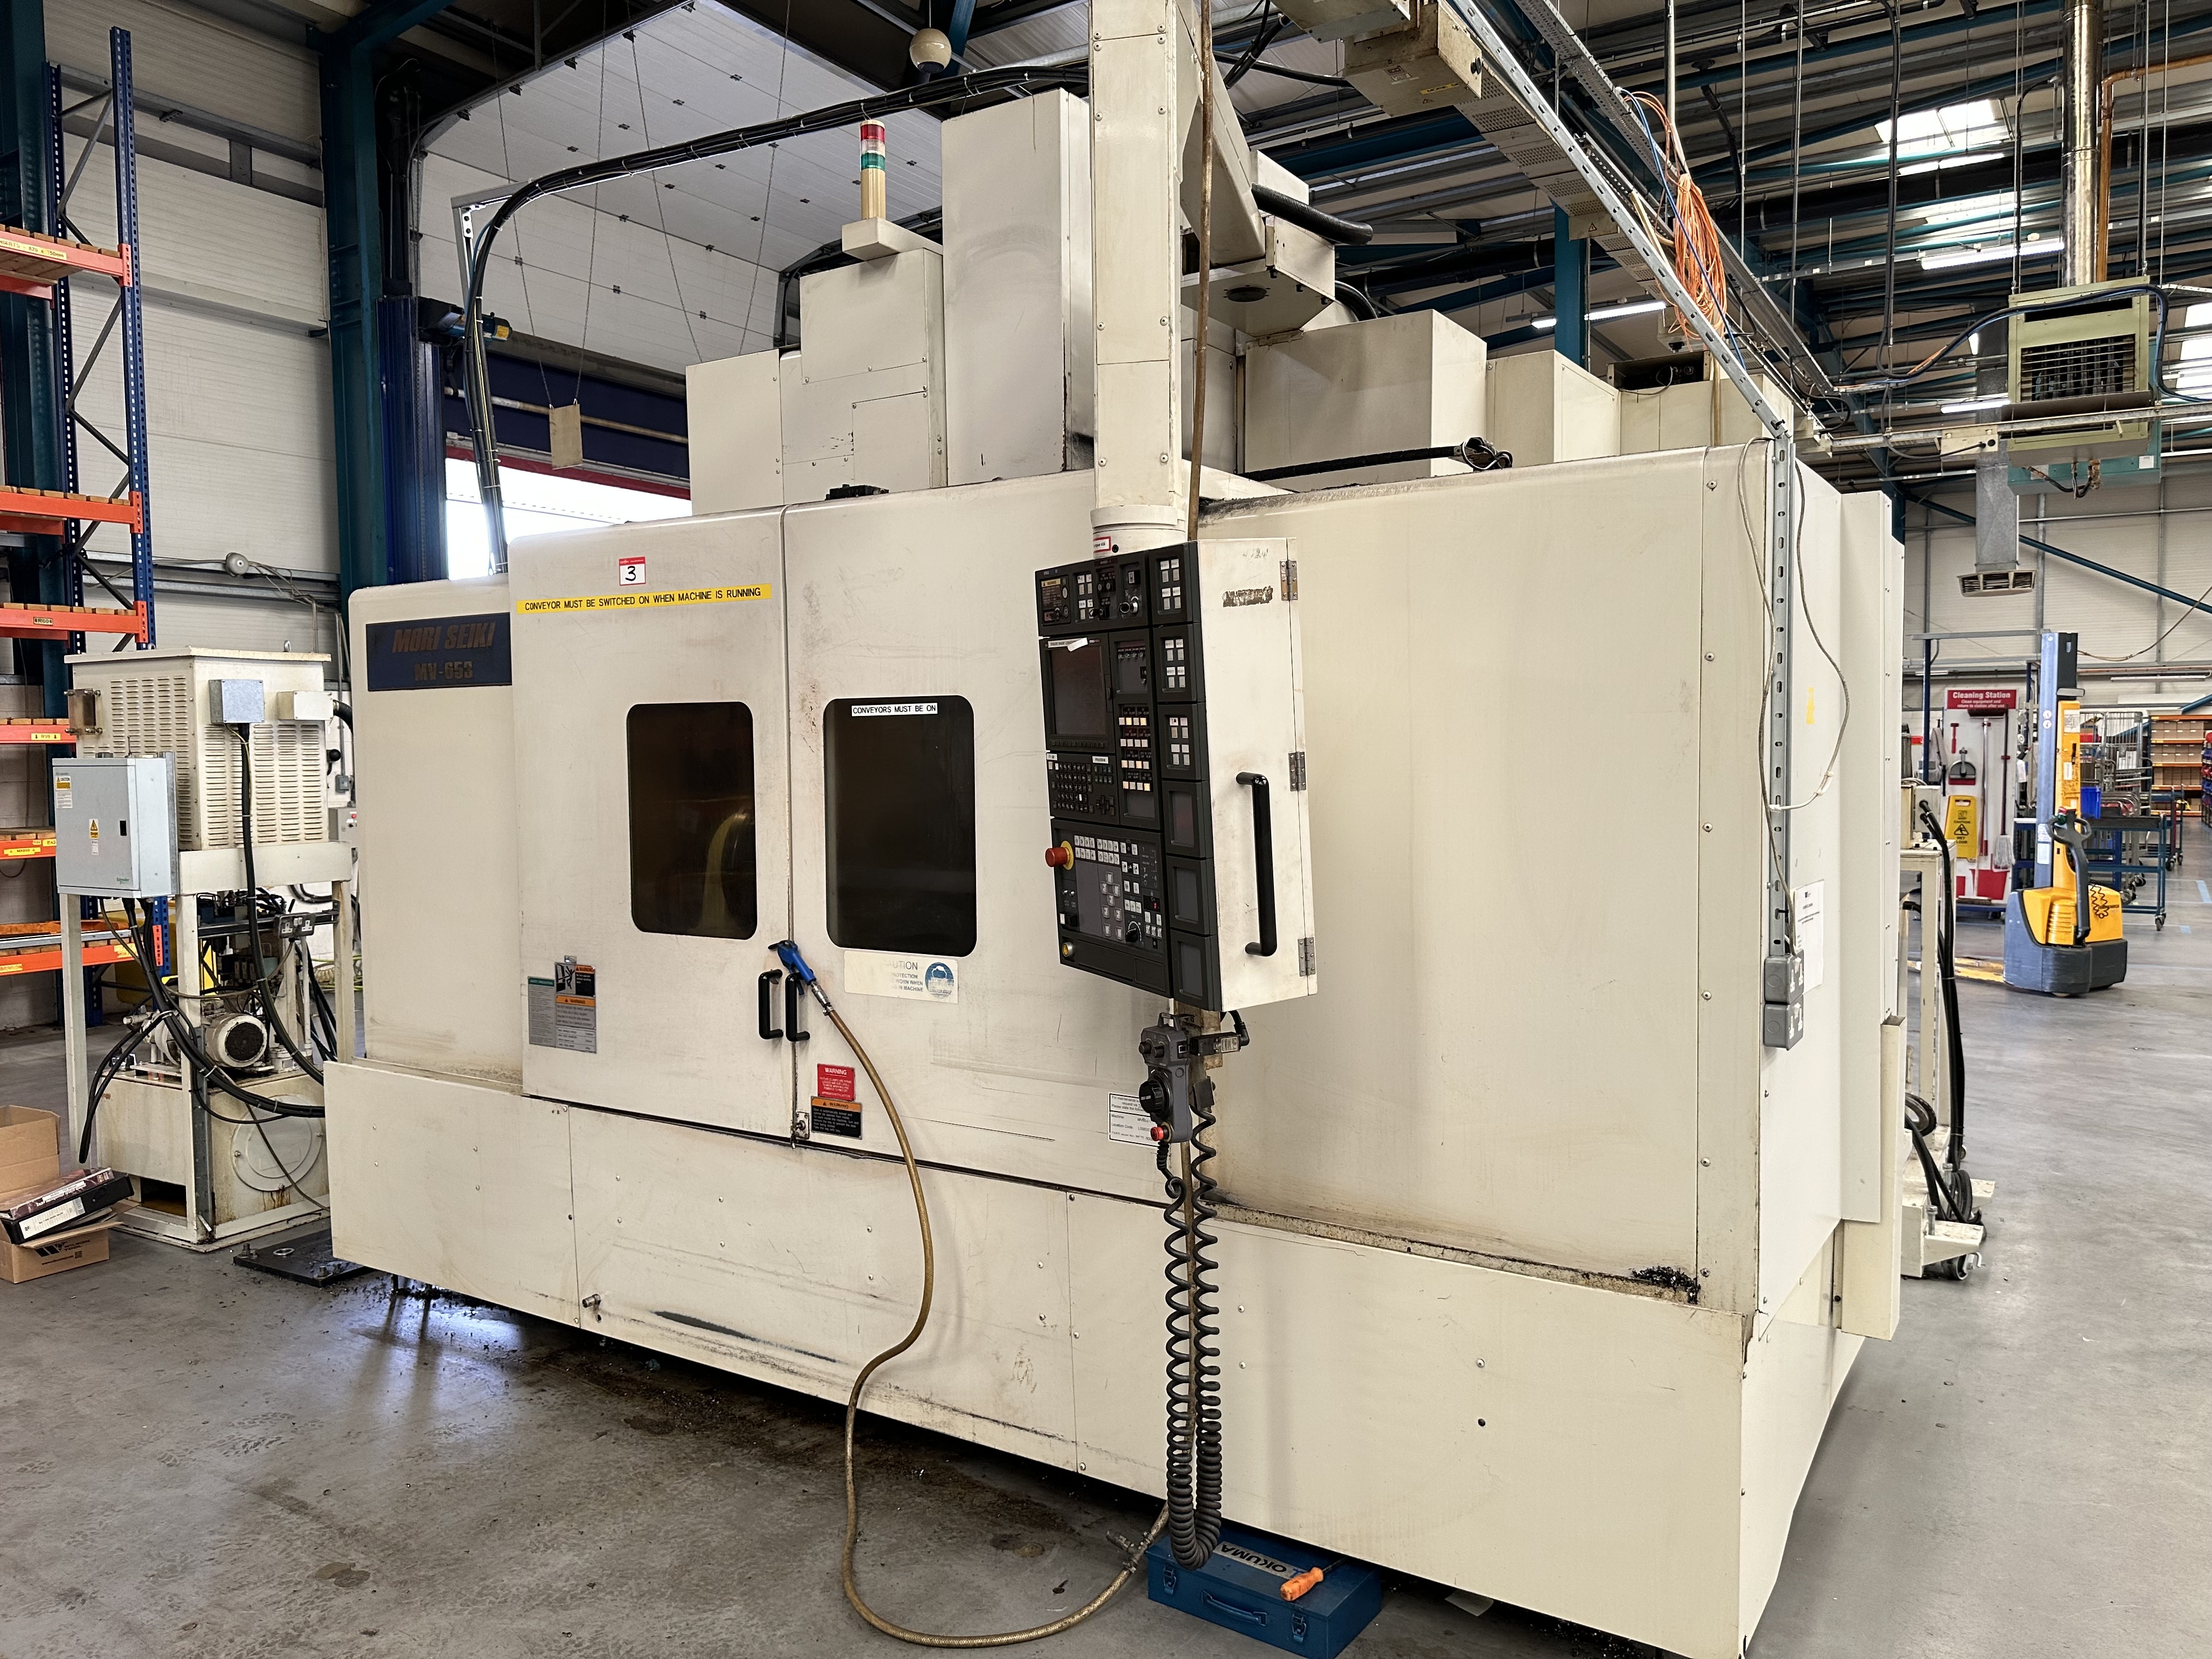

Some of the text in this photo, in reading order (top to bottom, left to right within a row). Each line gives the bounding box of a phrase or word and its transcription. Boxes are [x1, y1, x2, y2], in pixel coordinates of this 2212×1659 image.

[625, 566, 636, 582] 3
[525, 588, 761, 610] CONVEYOR MUST BE SWITCHED ON WHEN MACHINE IS RUNNING
[392, 621, 496, 653] MORI SEIKI
[414, 661, 473, 681] MV-653
[824, 1067, 847, 1075] WARNING
[1221, 1544, 1287, 1572] OKUMA
